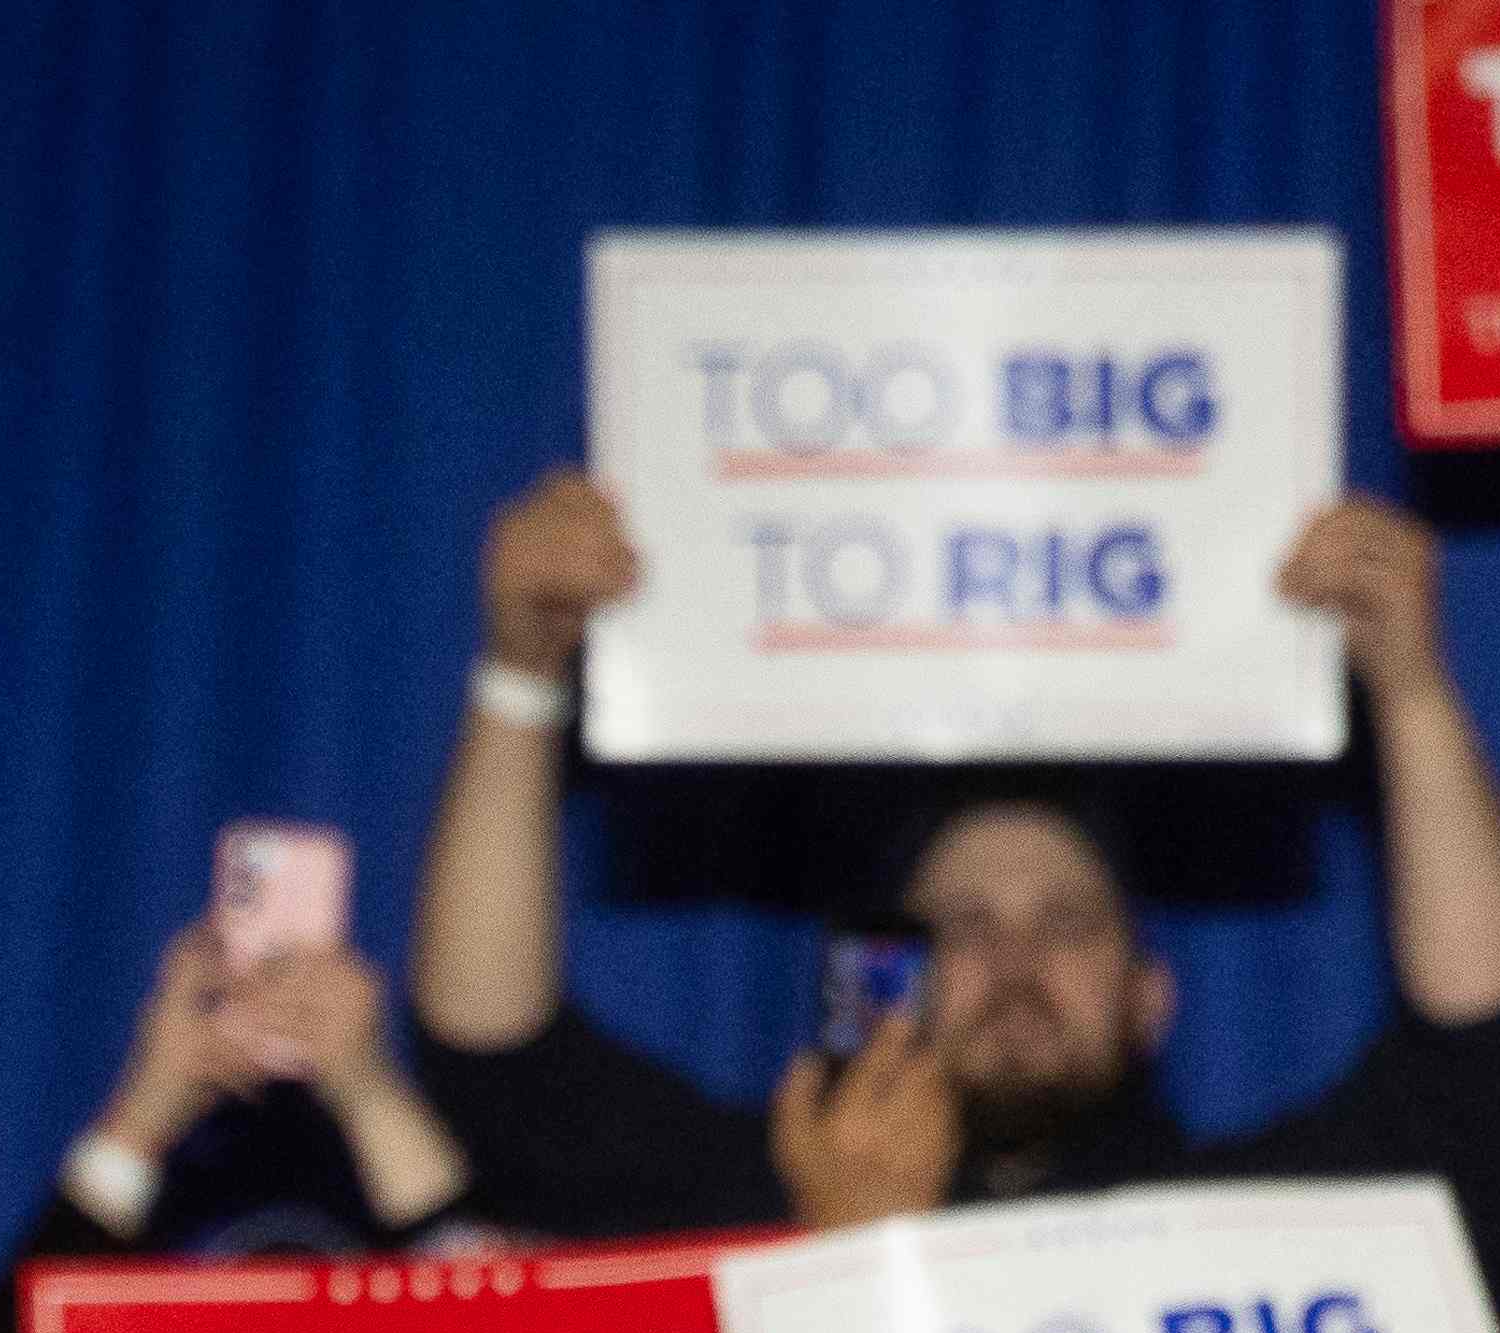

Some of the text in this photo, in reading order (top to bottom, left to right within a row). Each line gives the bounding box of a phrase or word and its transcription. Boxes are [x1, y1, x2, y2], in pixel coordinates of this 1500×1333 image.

[682, 340, 1217, 453] TOO BIG
[734, 516, 1168, 627] TO RIG
